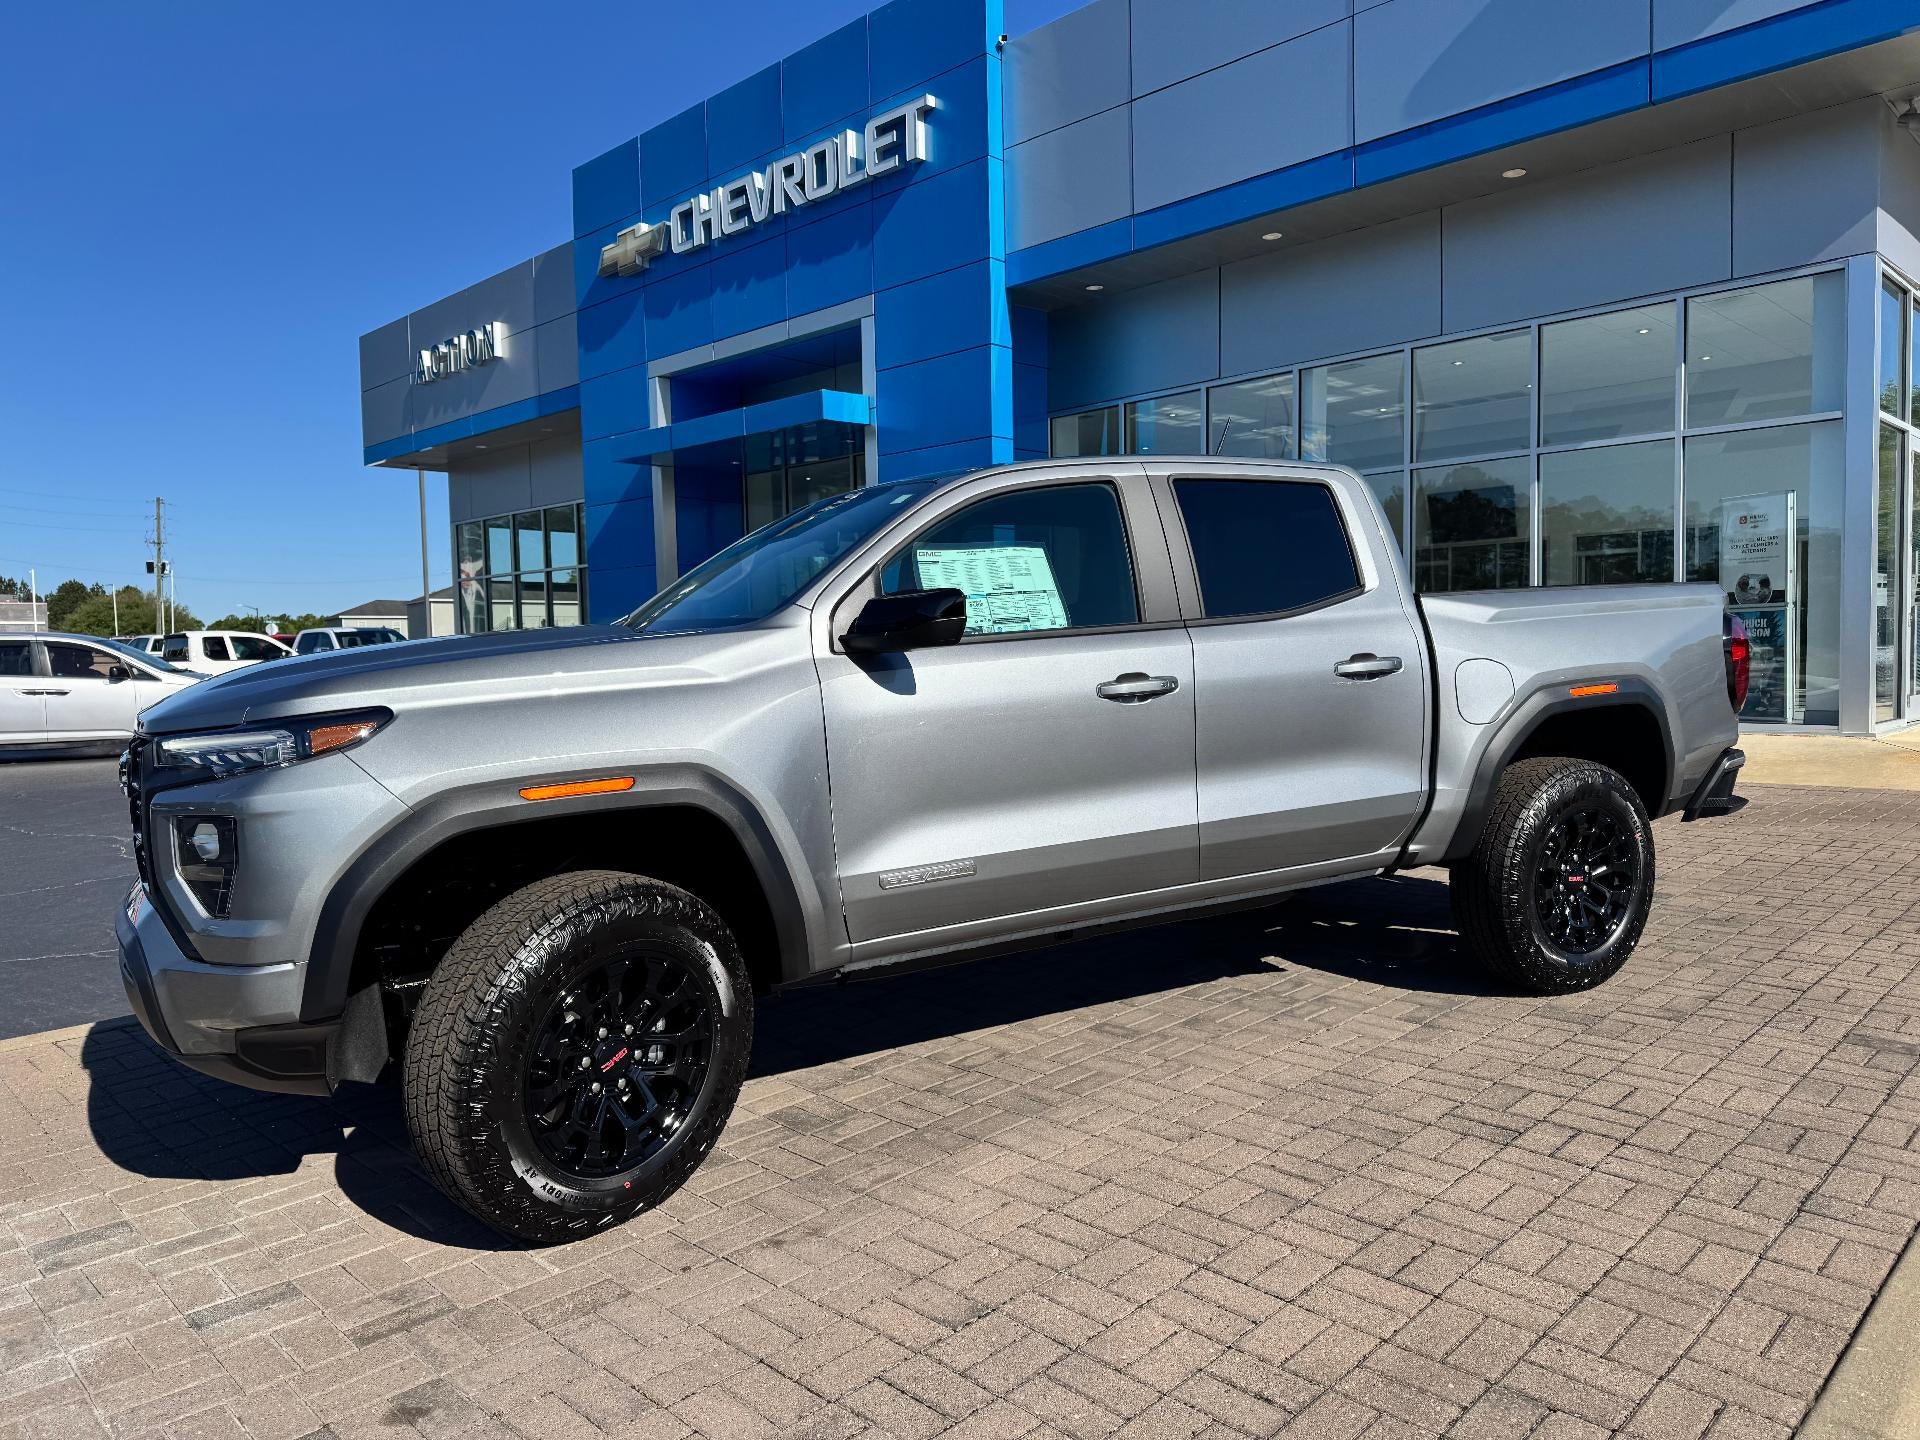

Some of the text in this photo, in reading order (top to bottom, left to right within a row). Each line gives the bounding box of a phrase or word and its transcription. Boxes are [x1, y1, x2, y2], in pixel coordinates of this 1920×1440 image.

[670, 93, 936, 254] CHEVROLET
[415, 321, 504, 385] ACTION
[1742, 618, 1768, 628] RUCK
[600, 1047, 628, 1073] GMC
